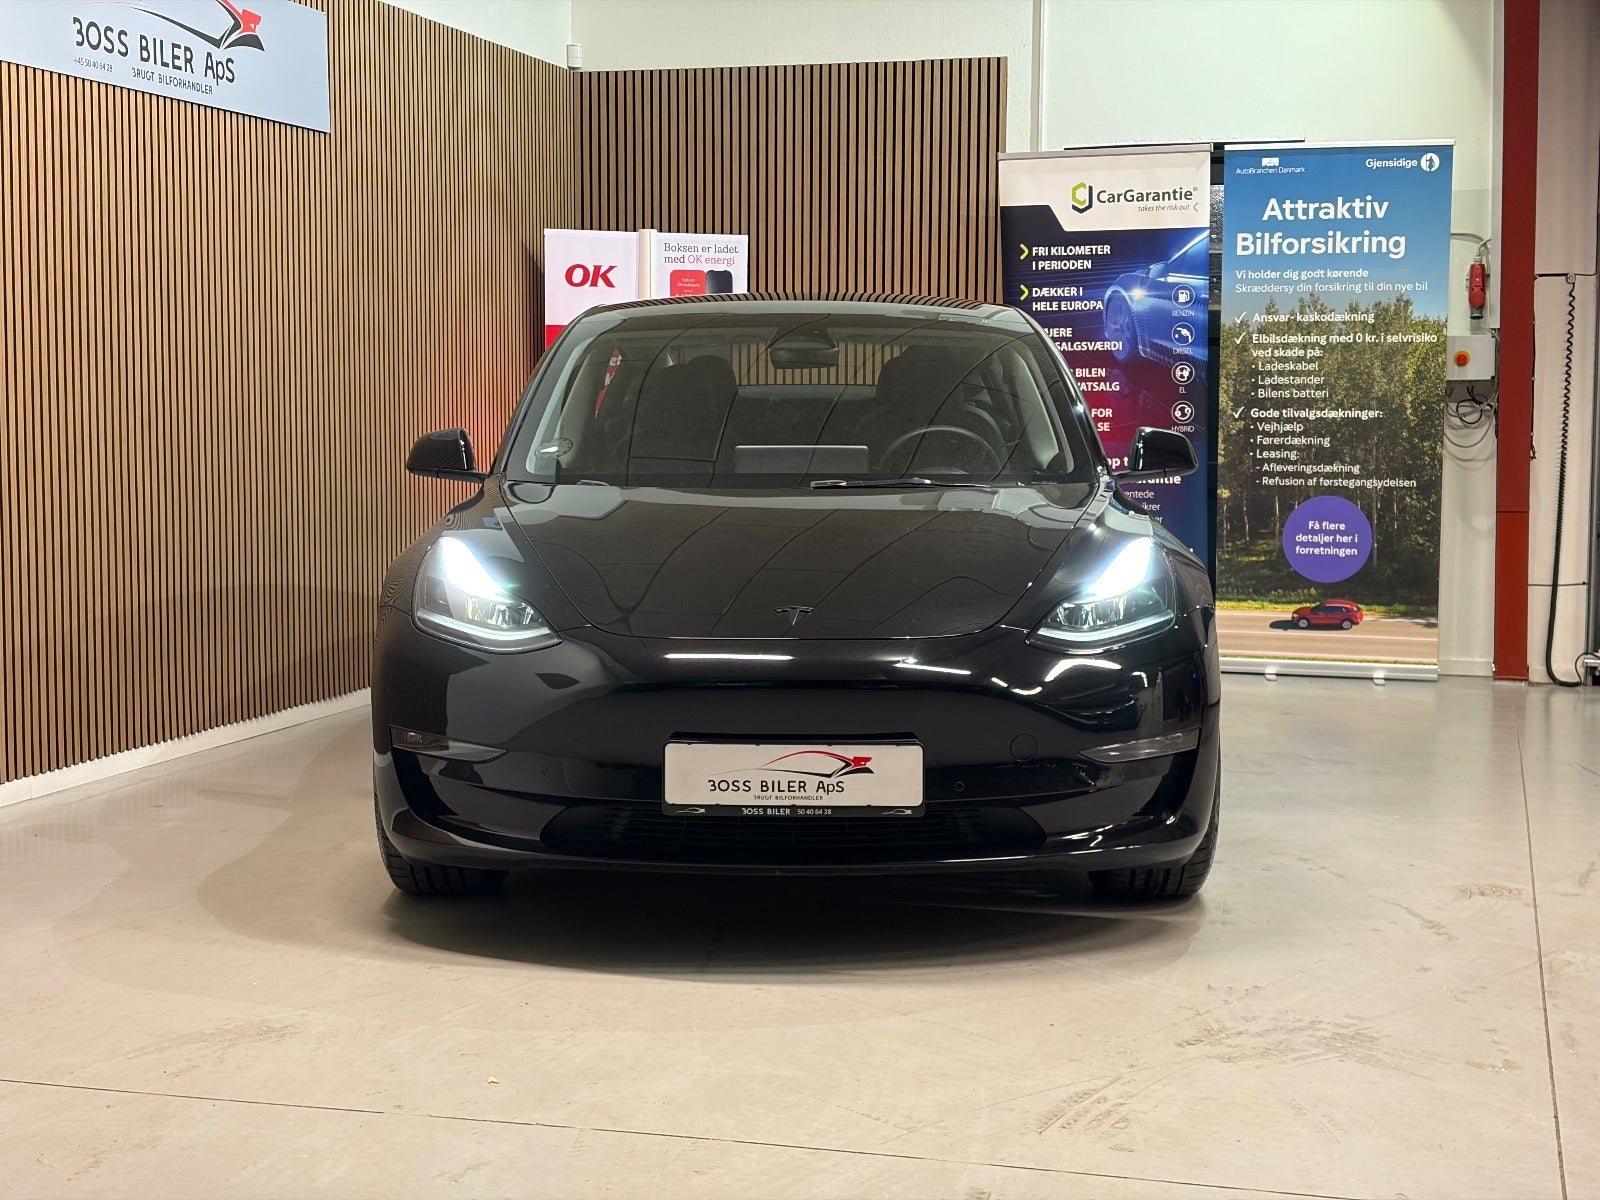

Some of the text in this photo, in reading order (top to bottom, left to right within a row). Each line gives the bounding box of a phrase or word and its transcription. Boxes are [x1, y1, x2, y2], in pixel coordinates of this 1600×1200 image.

[84, 59, 92, 67] 50
[92, 60, 99, 69] 40
[139, 34, 195, 74] BILER
[204, 51, 236, 86] ApS
[158, 73, 213, 95] BILFORHANDLER
[1278, 166, 1306, 174] Danmark
[1366, 158, 1418, 170] Gjensidige
[1138, 204, 1155, 212] takes
[1262, 194, 1389, 221] Attraktiv
[664, 242, 699, 252] Boksen
[714, 244, 739, 254] ladet
[1032, 244, 1111, 256] FRI KILOMETER
[1236, 230, 1406, 259] Bilforsikring
[664, 254, 735, 267] med OK energi
[1032, 260, 1092, 270] I PERIODEN
[564, 263, 618, 288] OK
[1235, 268, 1369, 280] Vi holder dig godt kørende
[1032, 287, 1083, 298] DÆKKER I
[1235, 281, 1428, 295] Skræddersy din forsikring til din nye bil
[1032, 300, 1104, 311] HELE EUROPA
[1297, 312, 1375, 324] kaskodækning
[1252, 333, 1437, 345] Elbilsdækning med 0 kr. i selvrisiko
[1252, 348, 1324, 359] ved skade på:
[1076, 368, 1106, 377] BILEN
[1258, 362, 1319, 371] Ladeskabel
[1258, 375, 1325, 385] Ladestander
[1258, 389, 1329, 398] Bilens batteri
[1092, 408, 1112, 417] FOR
[1250, 408, 1383, 420] Gode tilvalgsdækninger:
[1257, 422, 1304, 432] Vejhjælp
[1257, 435, 1330, 447] Førerdækning
[1257, 449, 1300, 460] Leasing:
[1262, 462, 1360, 474] Afleveringsdækning
[1262, 476, 1416, 488] Refusion af førstegangsydelsen
[1308, 521, 1346, 530] Få flere
[1296, 534, 1358, 544] detaljer her i
[1296, 546, 1358, 557] forretningen
[760, 780, 806, 793] BILER
[816, 780, 844, 795] ApS
